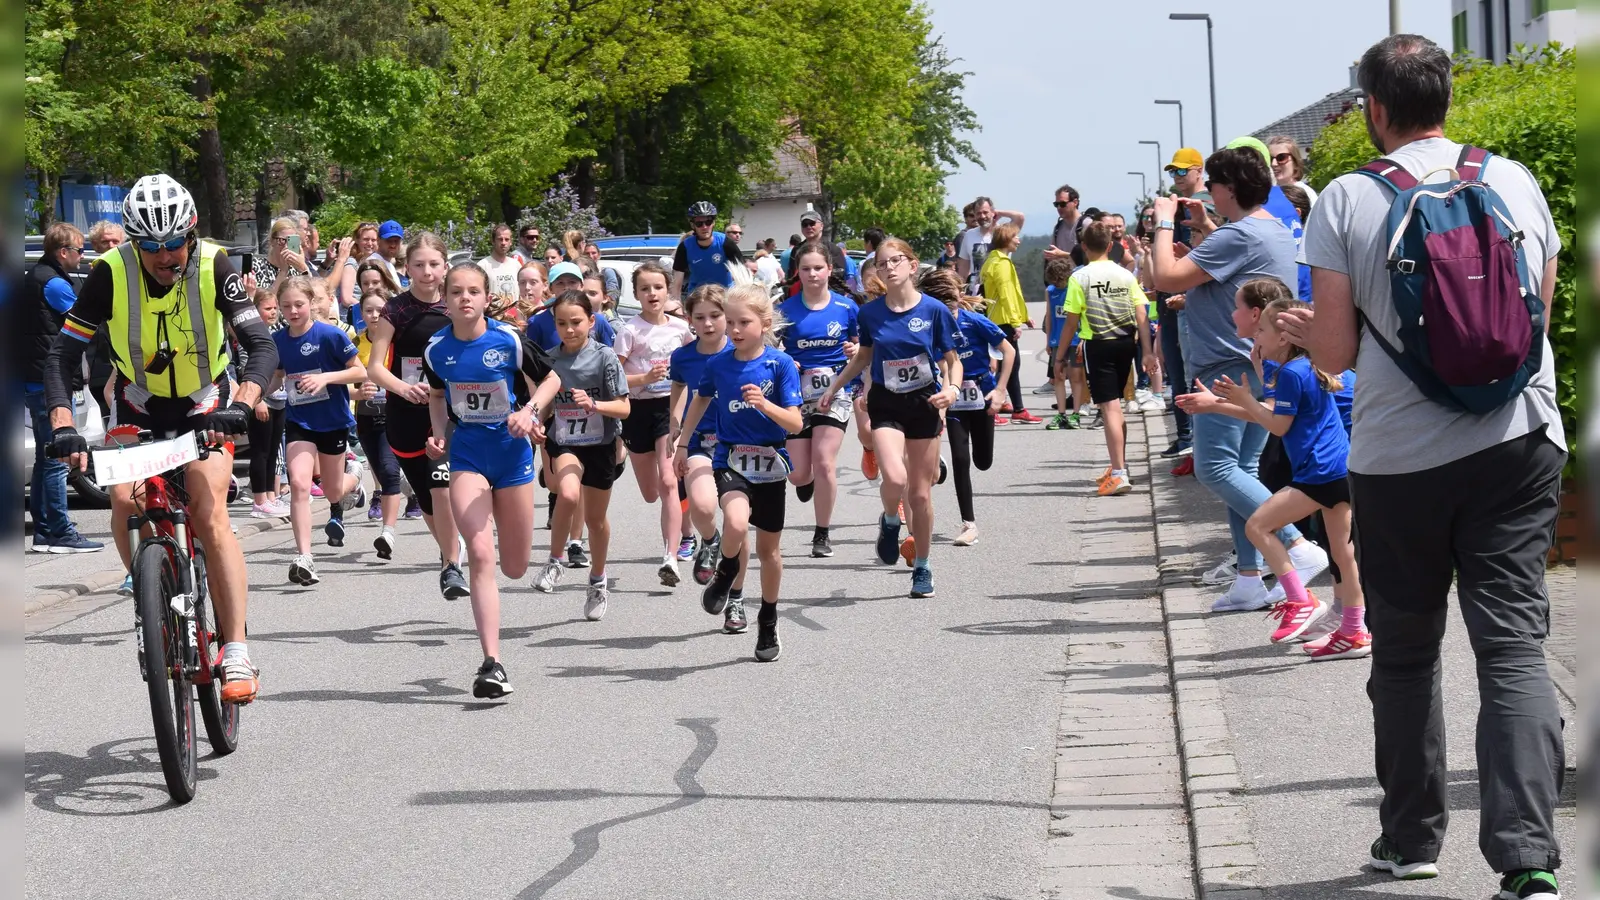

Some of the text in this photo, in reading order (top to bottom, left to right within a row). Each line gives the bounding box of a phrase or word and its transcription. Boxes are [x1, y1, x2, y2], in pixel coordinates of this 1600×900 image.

[797, 339, 838, 349] CONRAD
[811, 374, 831, 390] 60
[897, 366, 919, 382] 92
[466, 392, 491, 411] 97
[956, 387, 978, 401] 19
[566, 418, 588, 435] 77
[128, 449, 189, 478] Läufer
[738, 454, 776, 472] 117
